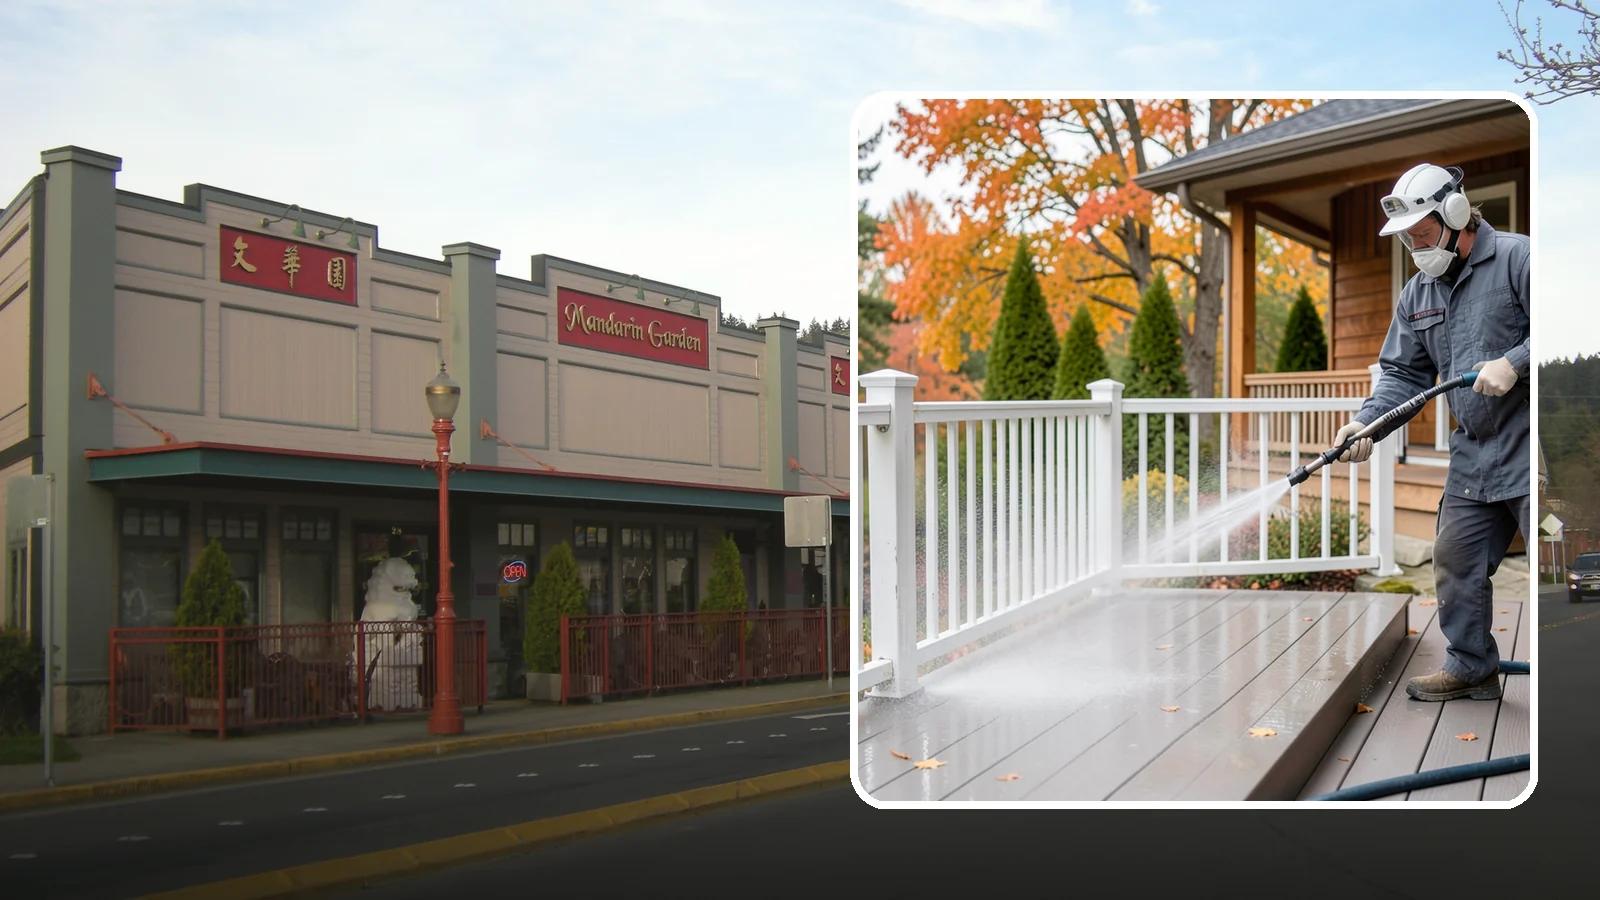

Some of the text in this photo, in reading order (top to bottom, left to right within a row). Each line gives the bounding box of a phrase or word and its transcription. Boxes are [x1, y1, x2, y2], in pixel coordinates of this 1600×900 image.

[231, 235, 346, 291] 文華園
[564, 302, 702, 352] Mandarin Garden
[503, 565, 527, 578] OPEN
